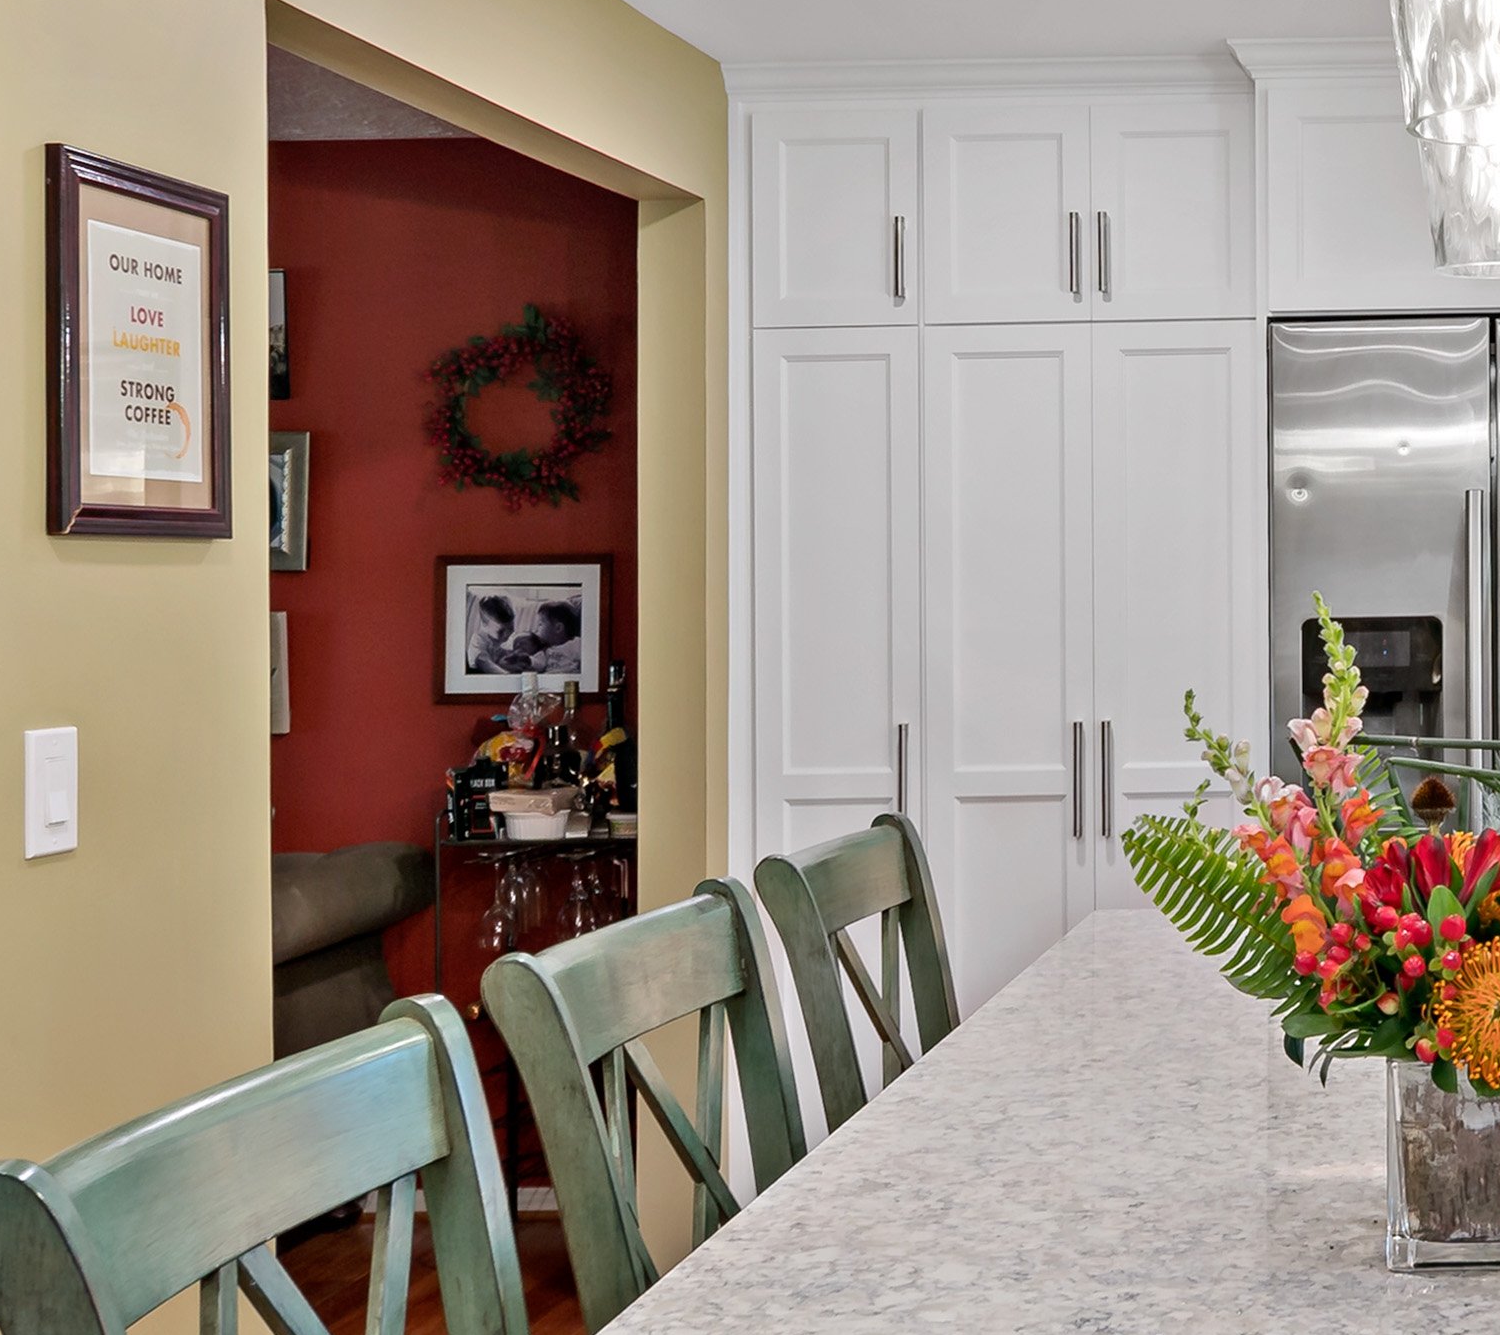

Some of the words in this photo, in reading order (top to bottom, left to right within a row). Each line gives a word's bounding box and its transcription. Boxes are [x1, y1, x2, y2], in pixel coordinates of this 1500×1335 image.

[109, 253, 139, 276] OUR
[143, 261, 183, 285] HOME
[130, 305, 164, 328] LOVE
[112, 327, 181, 358] LAUGHTER
[120, 379, 175, 403] STRONG
[125, 404, 172, 426] COFFEE
